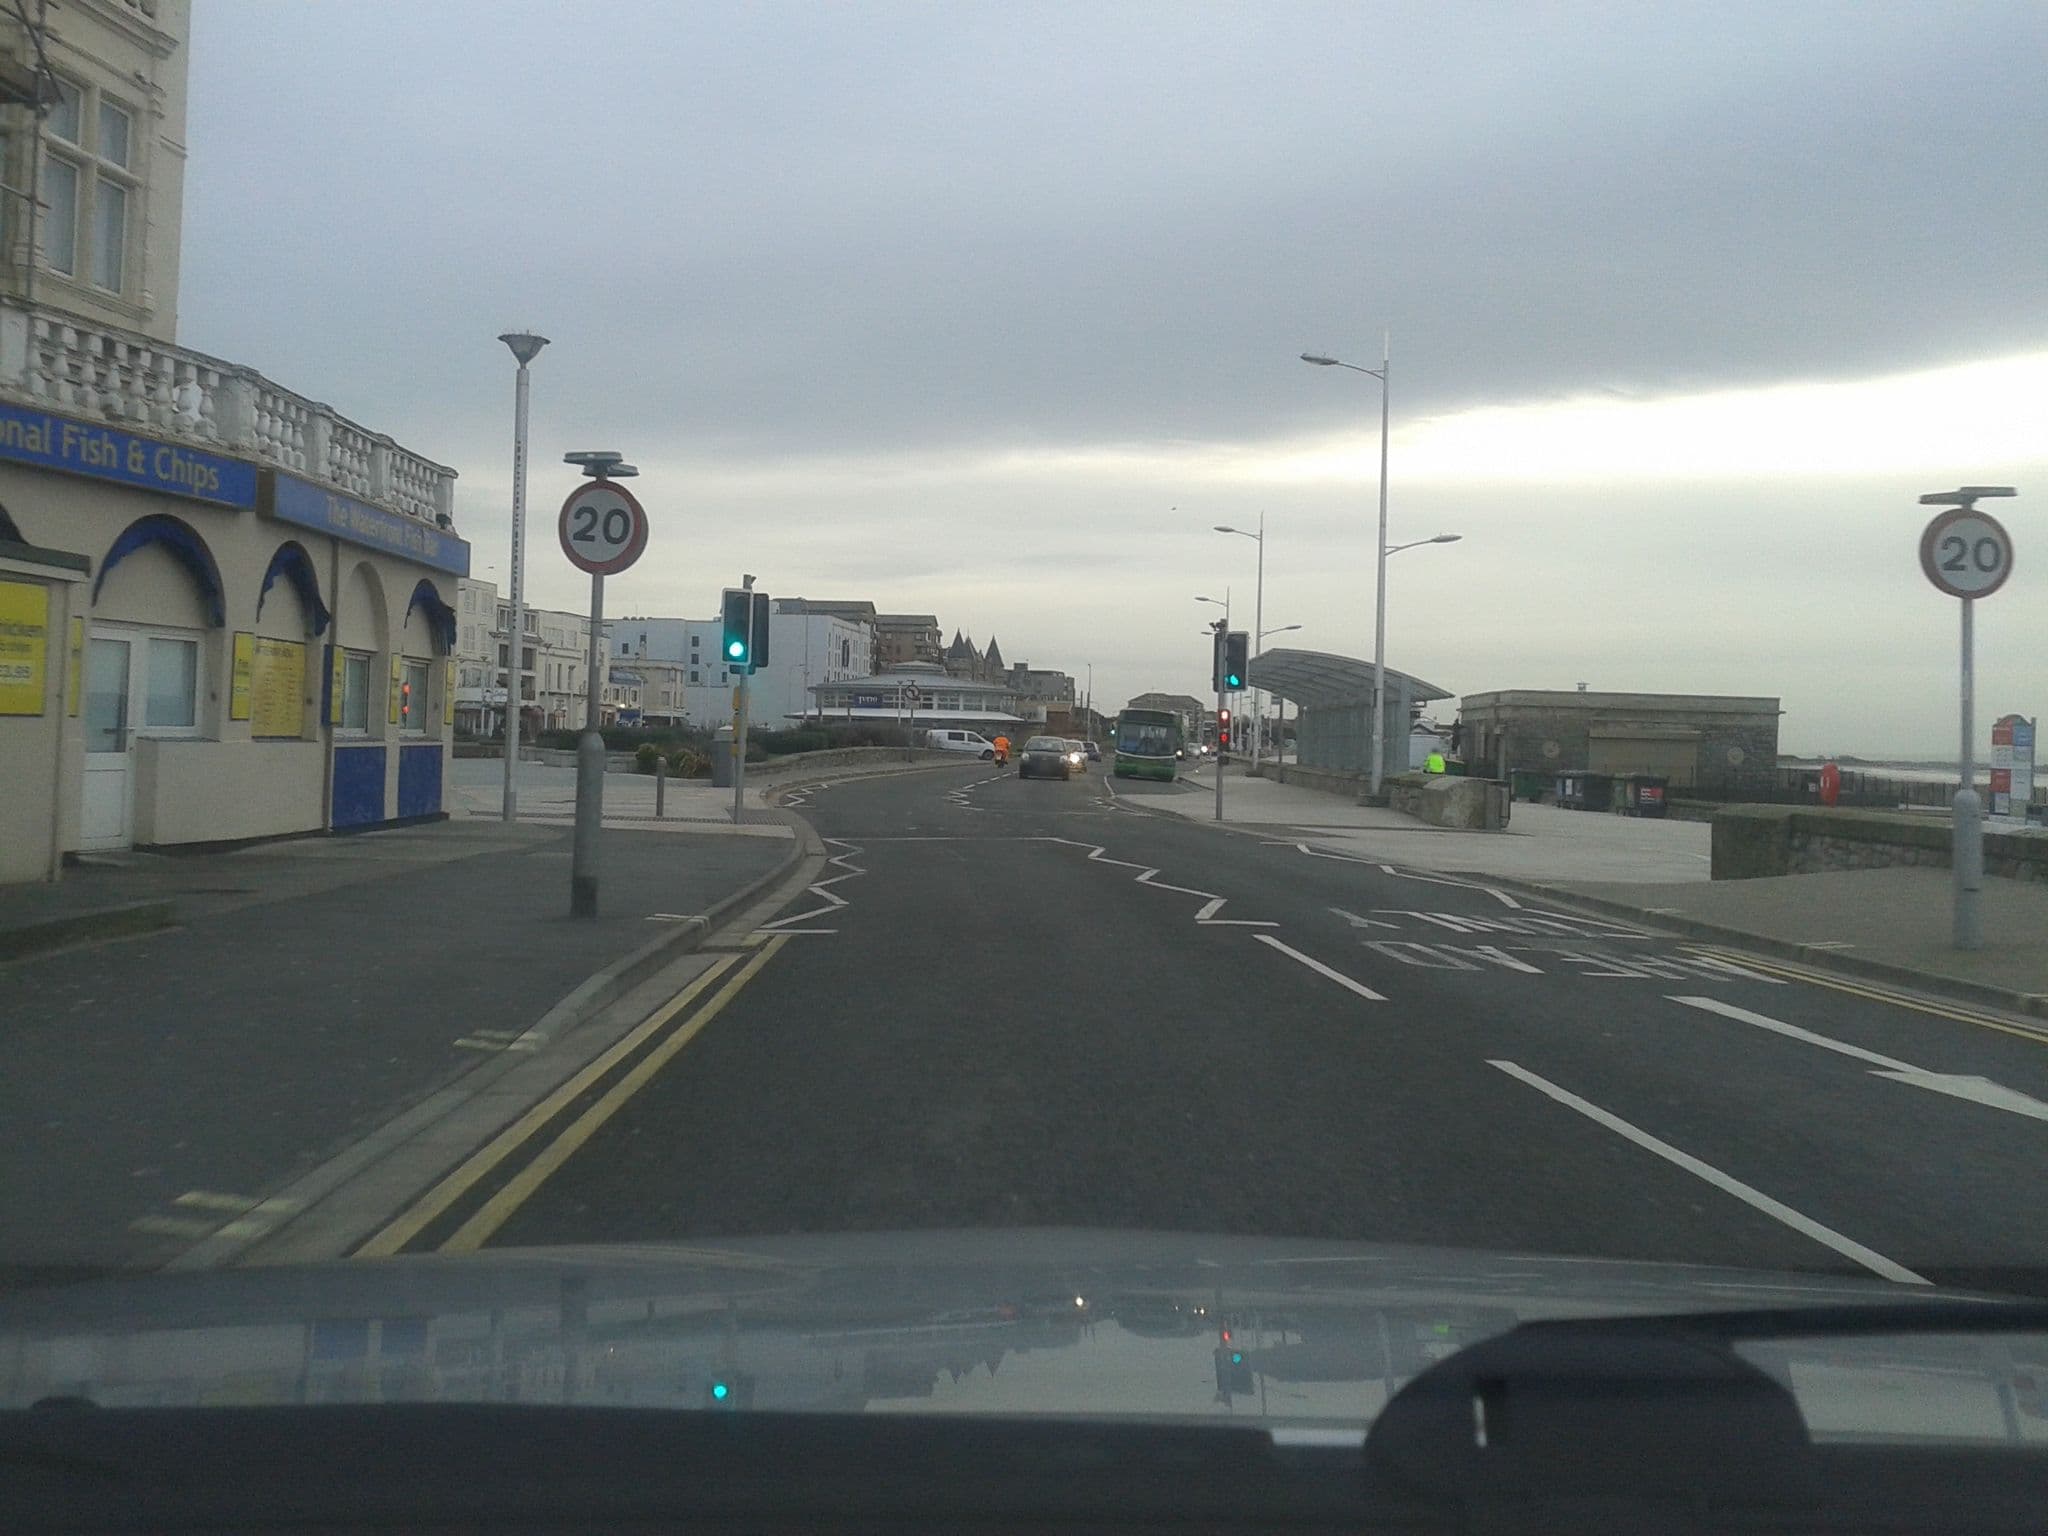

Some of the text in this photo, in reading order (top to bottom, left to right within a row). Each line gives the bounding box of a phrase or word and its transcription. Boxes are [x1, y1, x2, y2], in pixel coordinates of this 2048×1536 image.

[62, 423, 117, 469] Fish
[127, 439, 146, 476] &
[154, 446, 220, 494] Chips
[573, 505, 631, 545] 20
[1942, 536, 2000, 573] 20
